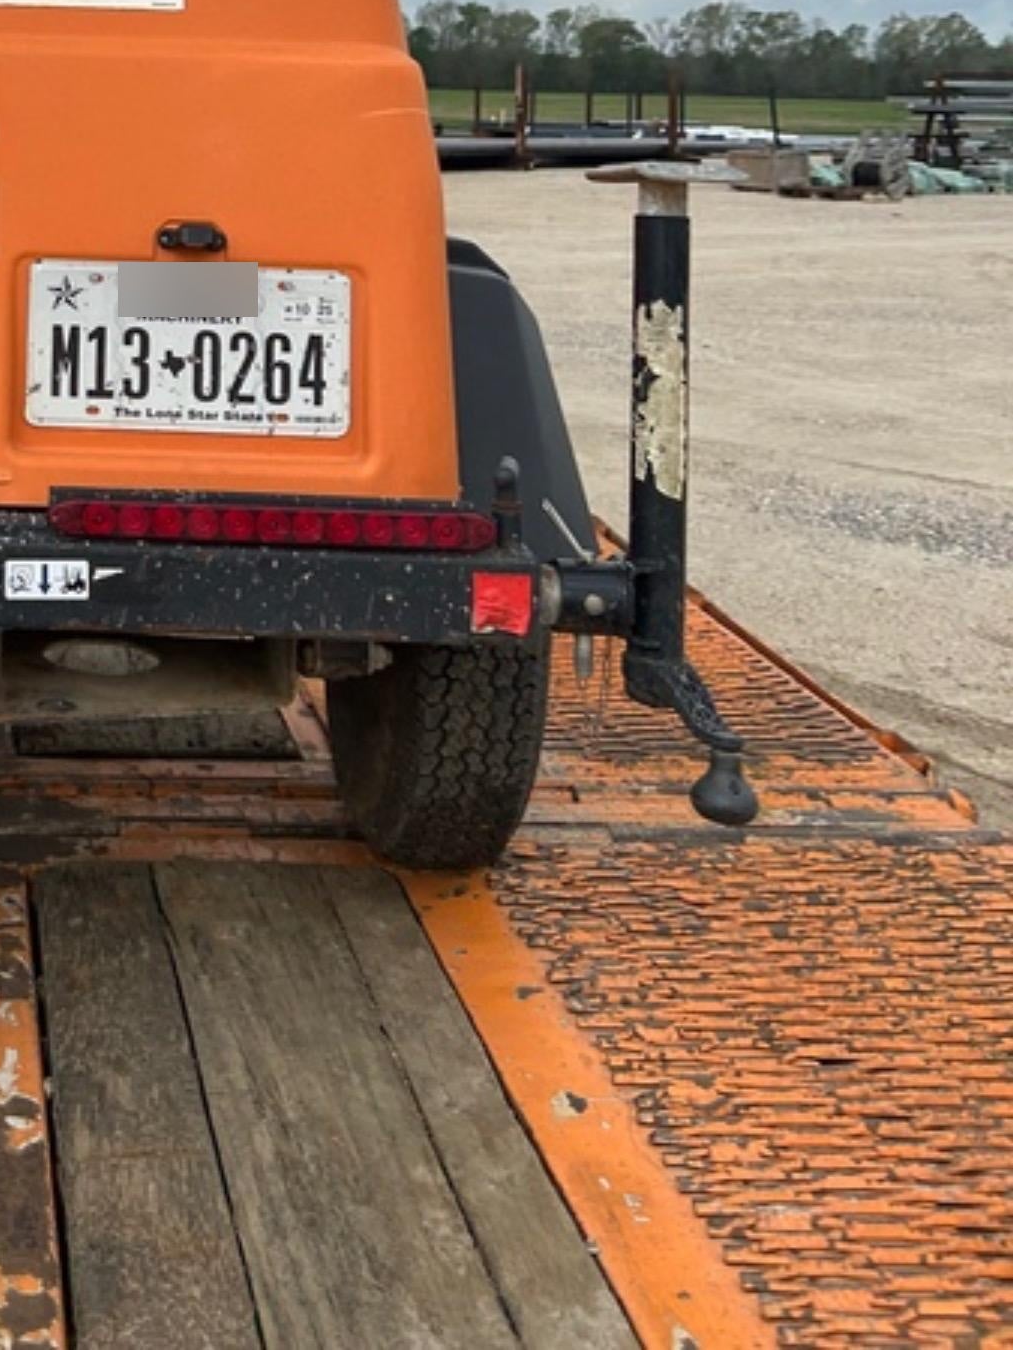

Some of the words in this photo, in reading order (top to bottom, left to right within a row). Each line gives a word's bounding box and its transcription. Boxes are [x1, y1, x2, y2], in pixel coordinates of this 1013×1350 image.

[50, 323, 151, 400] M13
[192, 330, 328, 407] 0264
[113, 407, 141, 419] The
[187, 409, 219, 422] Star
[223, 410, 264, 423] State
